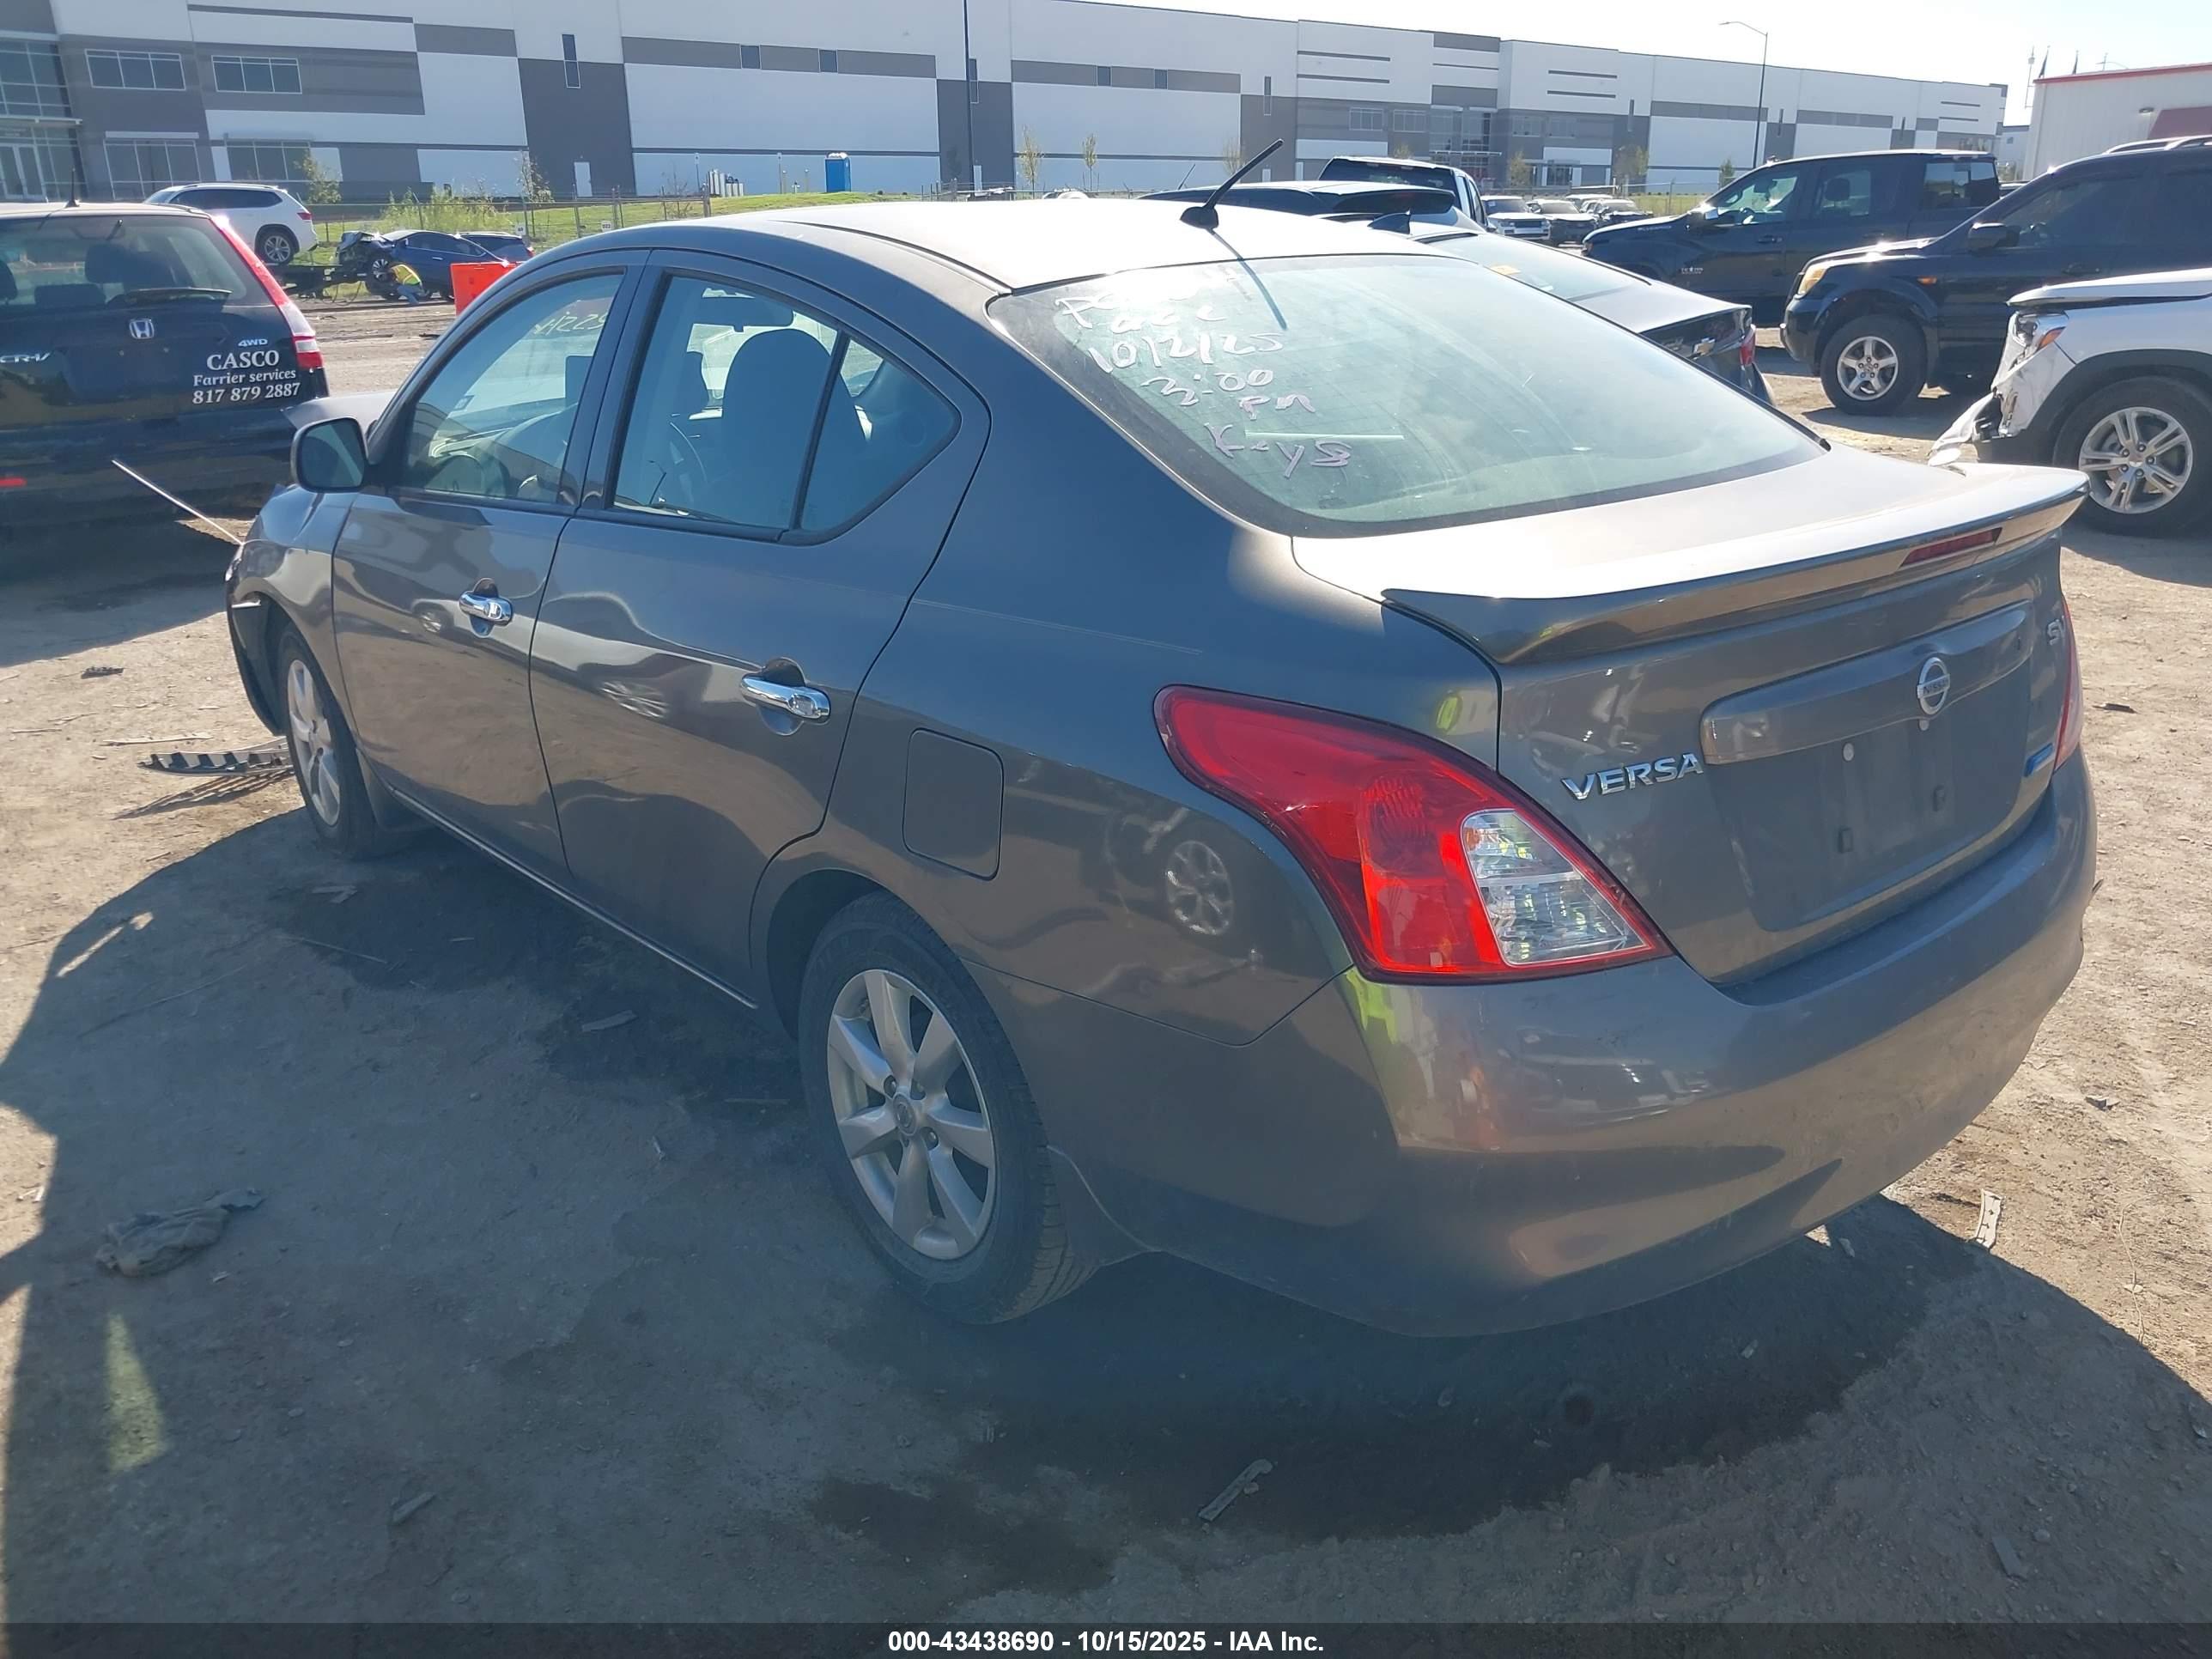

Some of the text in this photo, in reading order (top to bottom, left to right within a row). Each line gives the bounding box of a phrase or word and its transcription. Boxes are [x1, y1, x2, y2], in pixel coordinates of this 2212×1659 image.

[238, 338, 269, 348] 4WD
[206, 349, 280, 371] CASCO
[193, 368, 296, 387] Farrier services
[191, 382, 301, 404] 817 879 2887
[1560, 752, 1705, 800] VERSA
